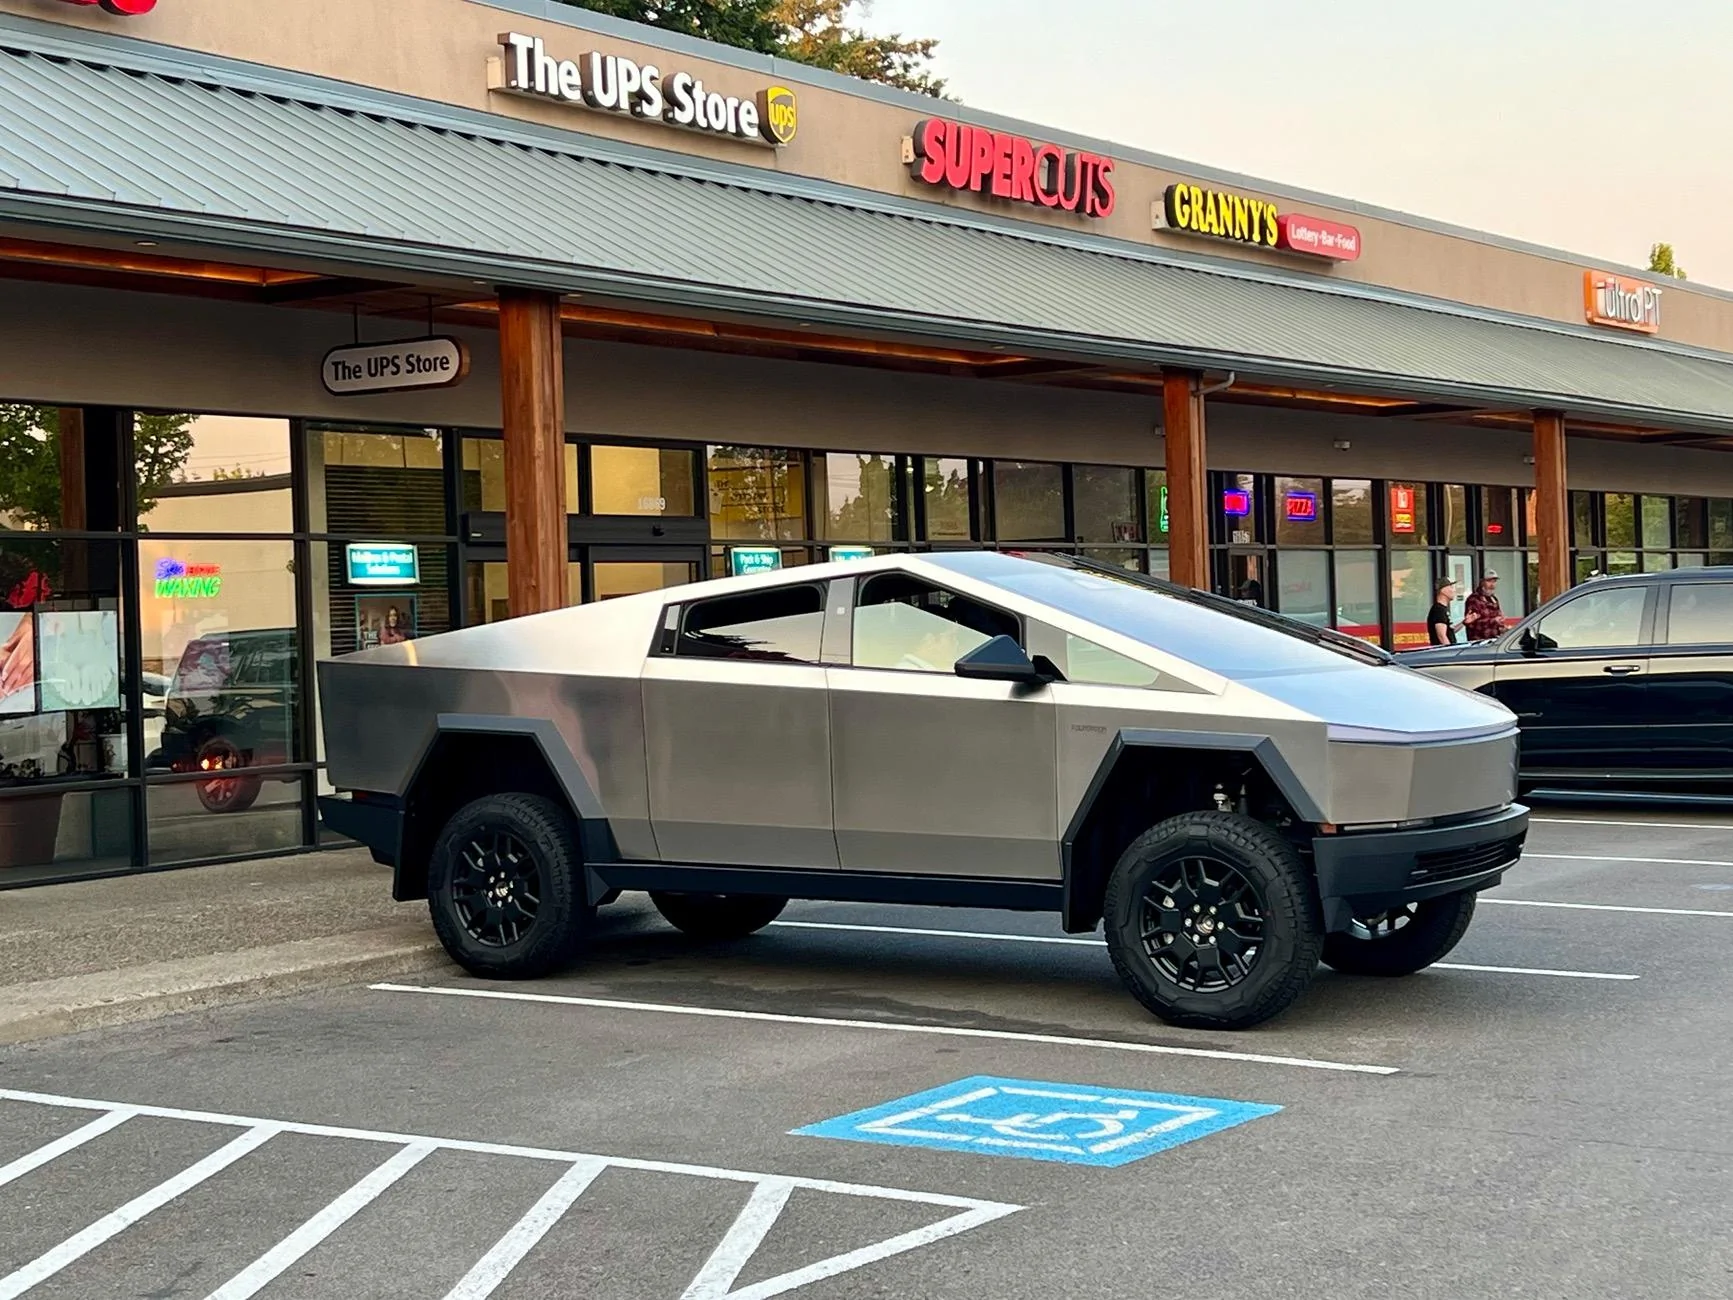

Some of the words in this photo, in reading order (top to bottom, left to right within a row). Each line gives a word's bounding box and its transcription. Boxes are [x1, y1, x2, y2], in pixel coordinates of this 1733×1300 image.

[508, 32, 582, 101] The
[589, 51, 664, 118] UPS
[671, 71, 760, 138] Store
[770, 103, 794, 134] ups
[920, 117, 1116, 218] SUPERCUTS
[1174, 183, 1279, 246] GRANNY'S
[331, 360, 362, 381] The
[367, 355, 400, 378] UPS
[405, 353, 450, 375] Store
[154, 576, 223, 599] WAXING
